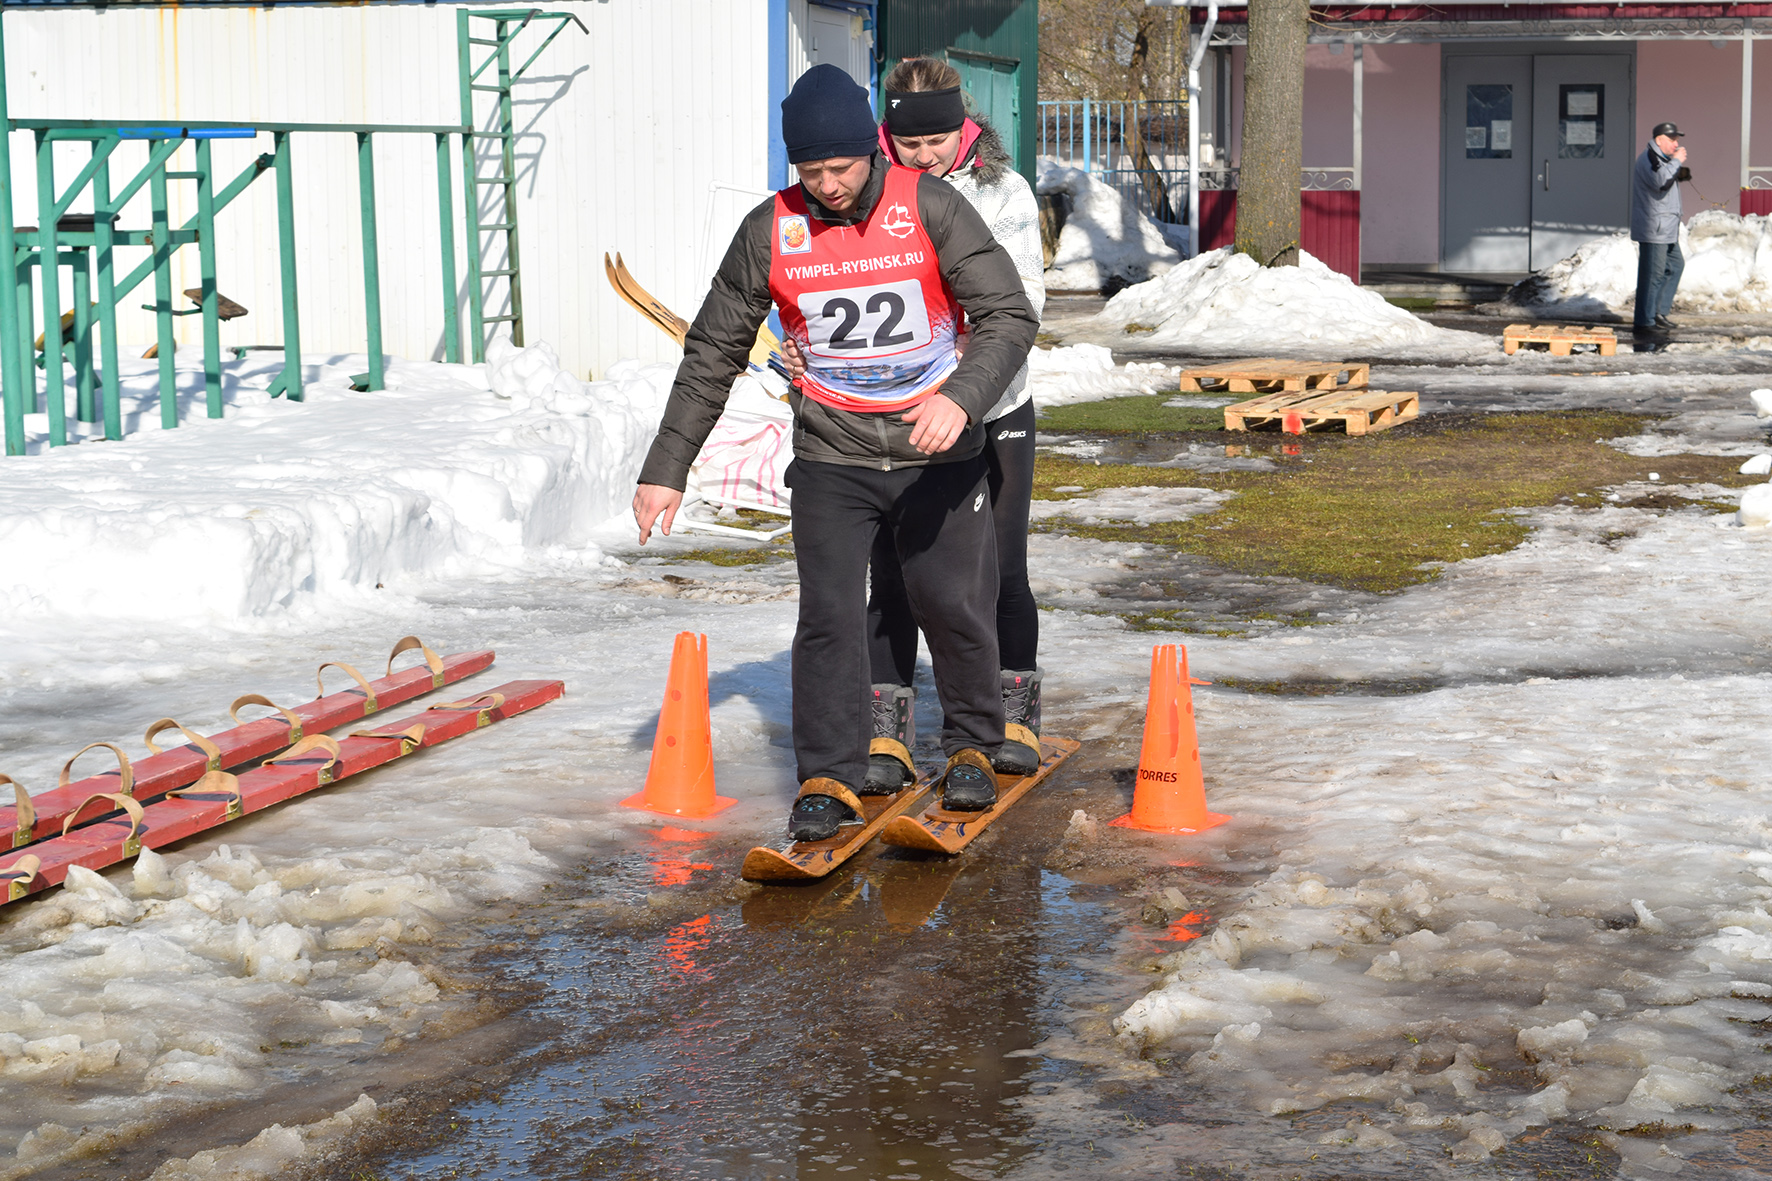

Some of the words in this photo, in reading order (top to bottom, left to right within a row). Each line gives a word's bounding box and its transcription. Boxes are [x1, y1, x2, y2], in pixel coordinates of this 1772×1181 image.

[785, 251, 924, 280] VYMPEL-RYBINSK.RU
[822, 291, 914, 349] 22
[1140, 769, 1178, 783] TORRES
